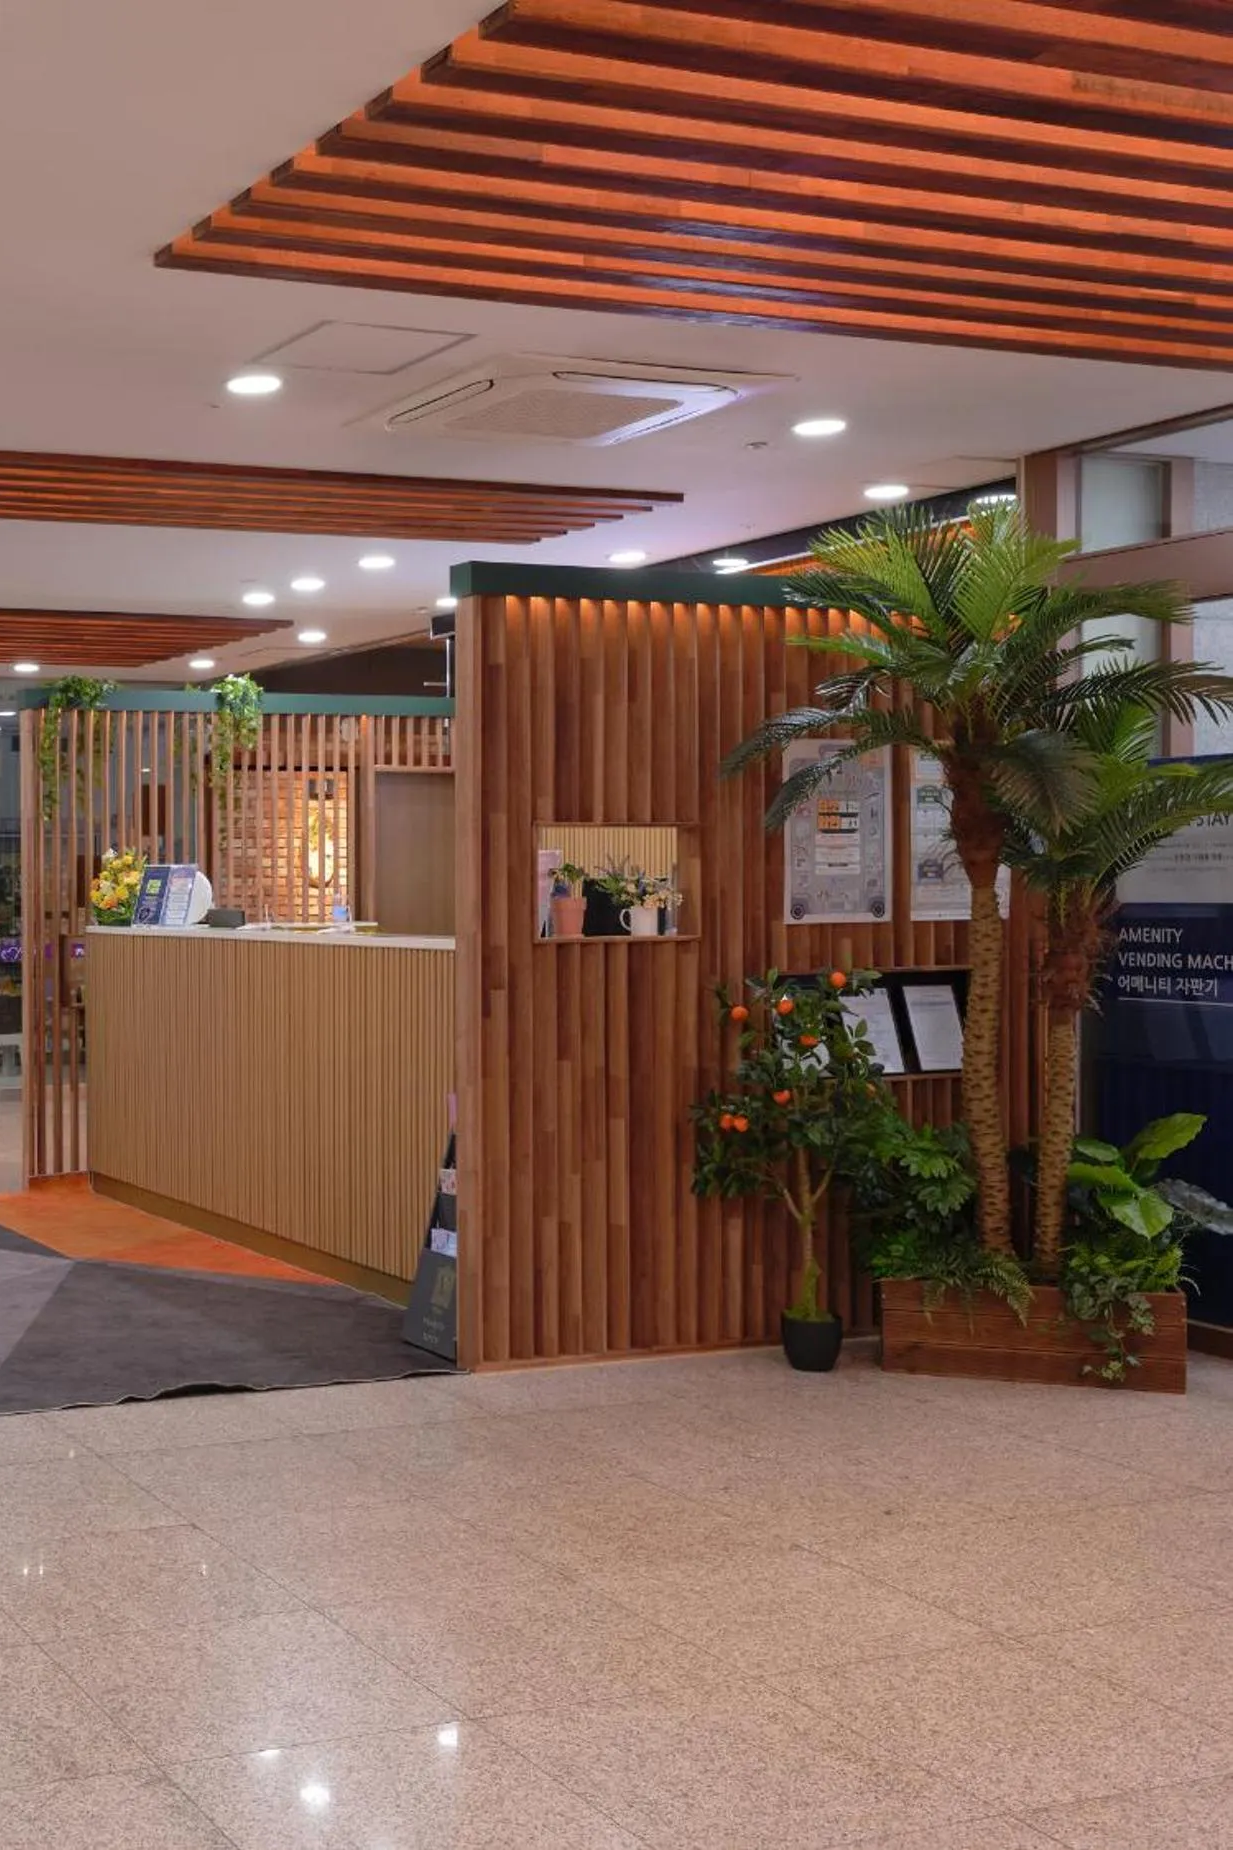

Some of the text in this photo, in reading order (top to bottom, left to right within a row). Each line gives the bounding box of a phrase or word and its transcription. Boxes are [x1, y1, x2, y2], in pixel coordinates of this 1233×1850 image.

[1118, 927, 1183, 944] AMENITY
[1117, 951, 1183, 969] VENDING
[1117, 974, 1218, 998] 어메니티 자판기
